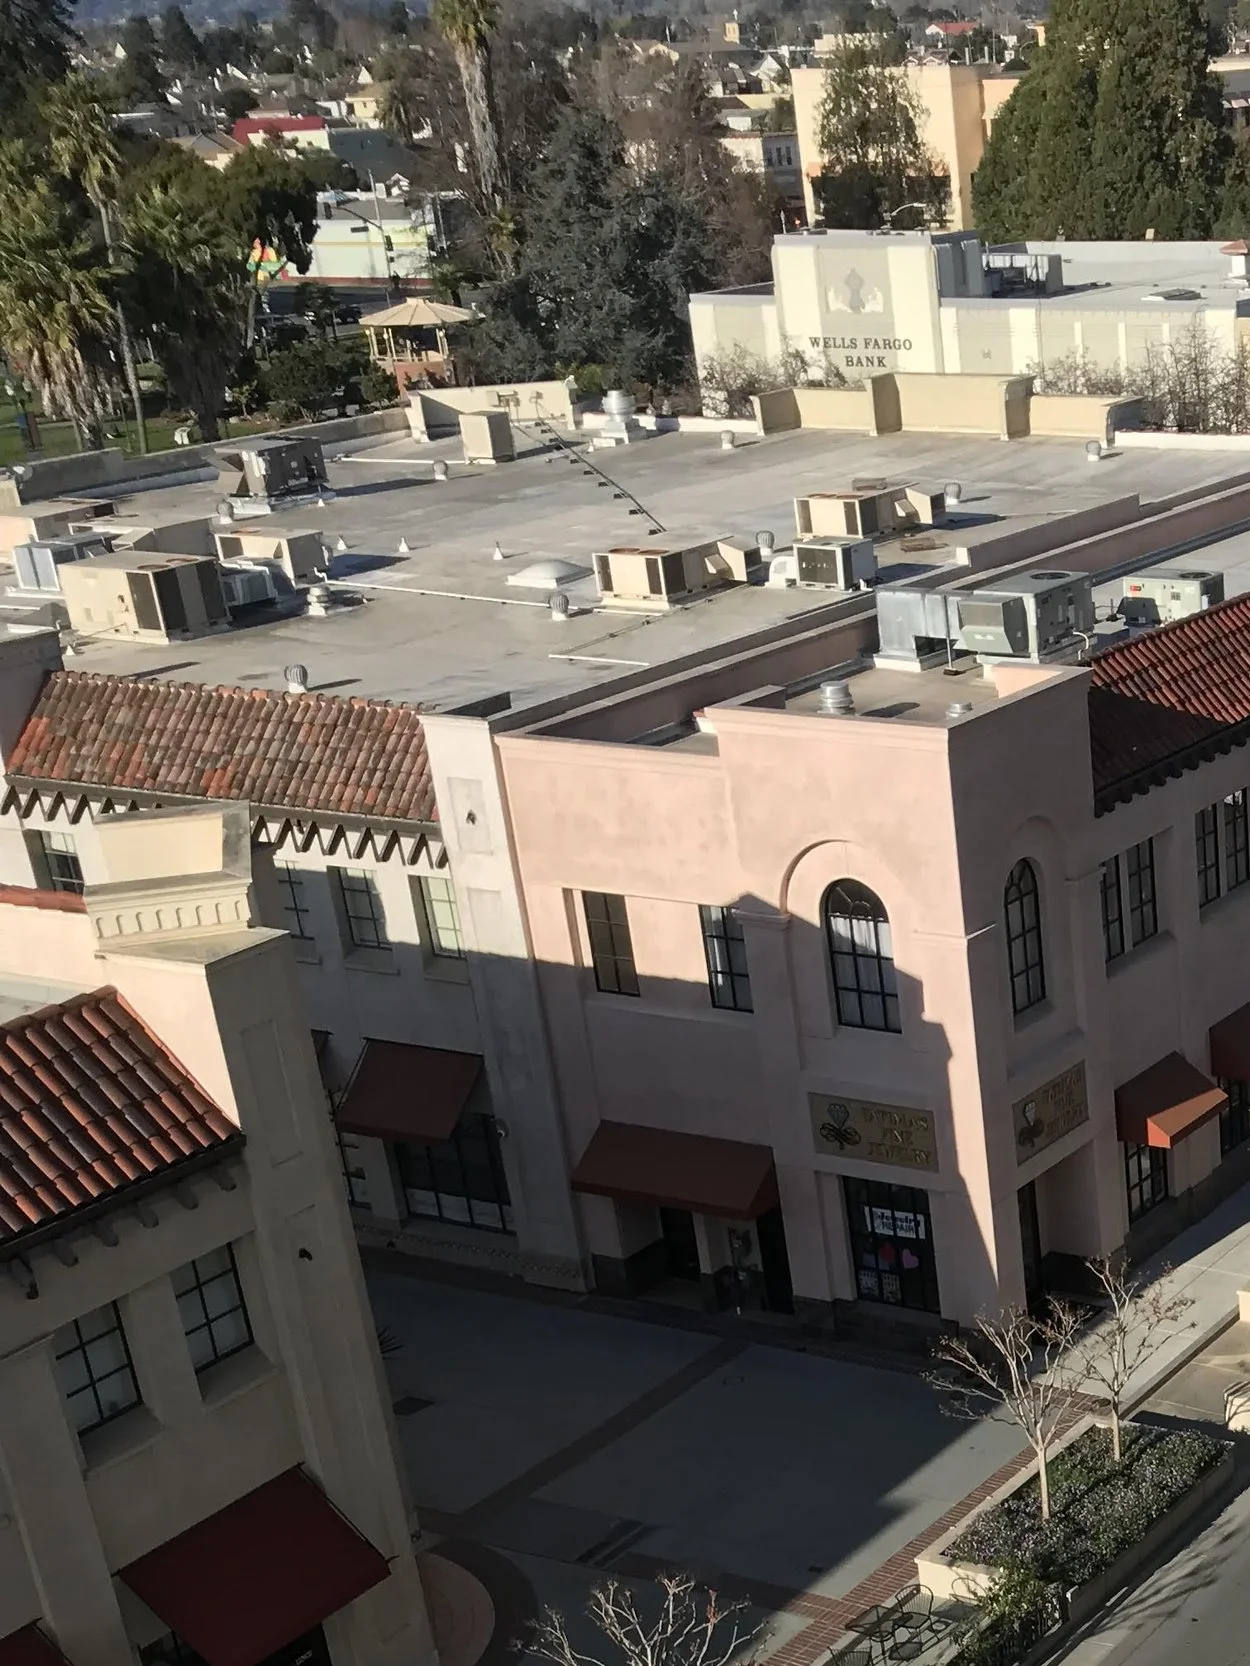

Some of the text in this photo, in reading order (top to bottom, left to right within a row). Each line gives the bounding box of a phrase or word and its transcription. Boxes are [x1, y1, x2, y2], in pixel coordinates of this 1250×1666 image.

[809, 336, 913, 351] WELLS FARGO
[845, 356, 887, 368] BANK
